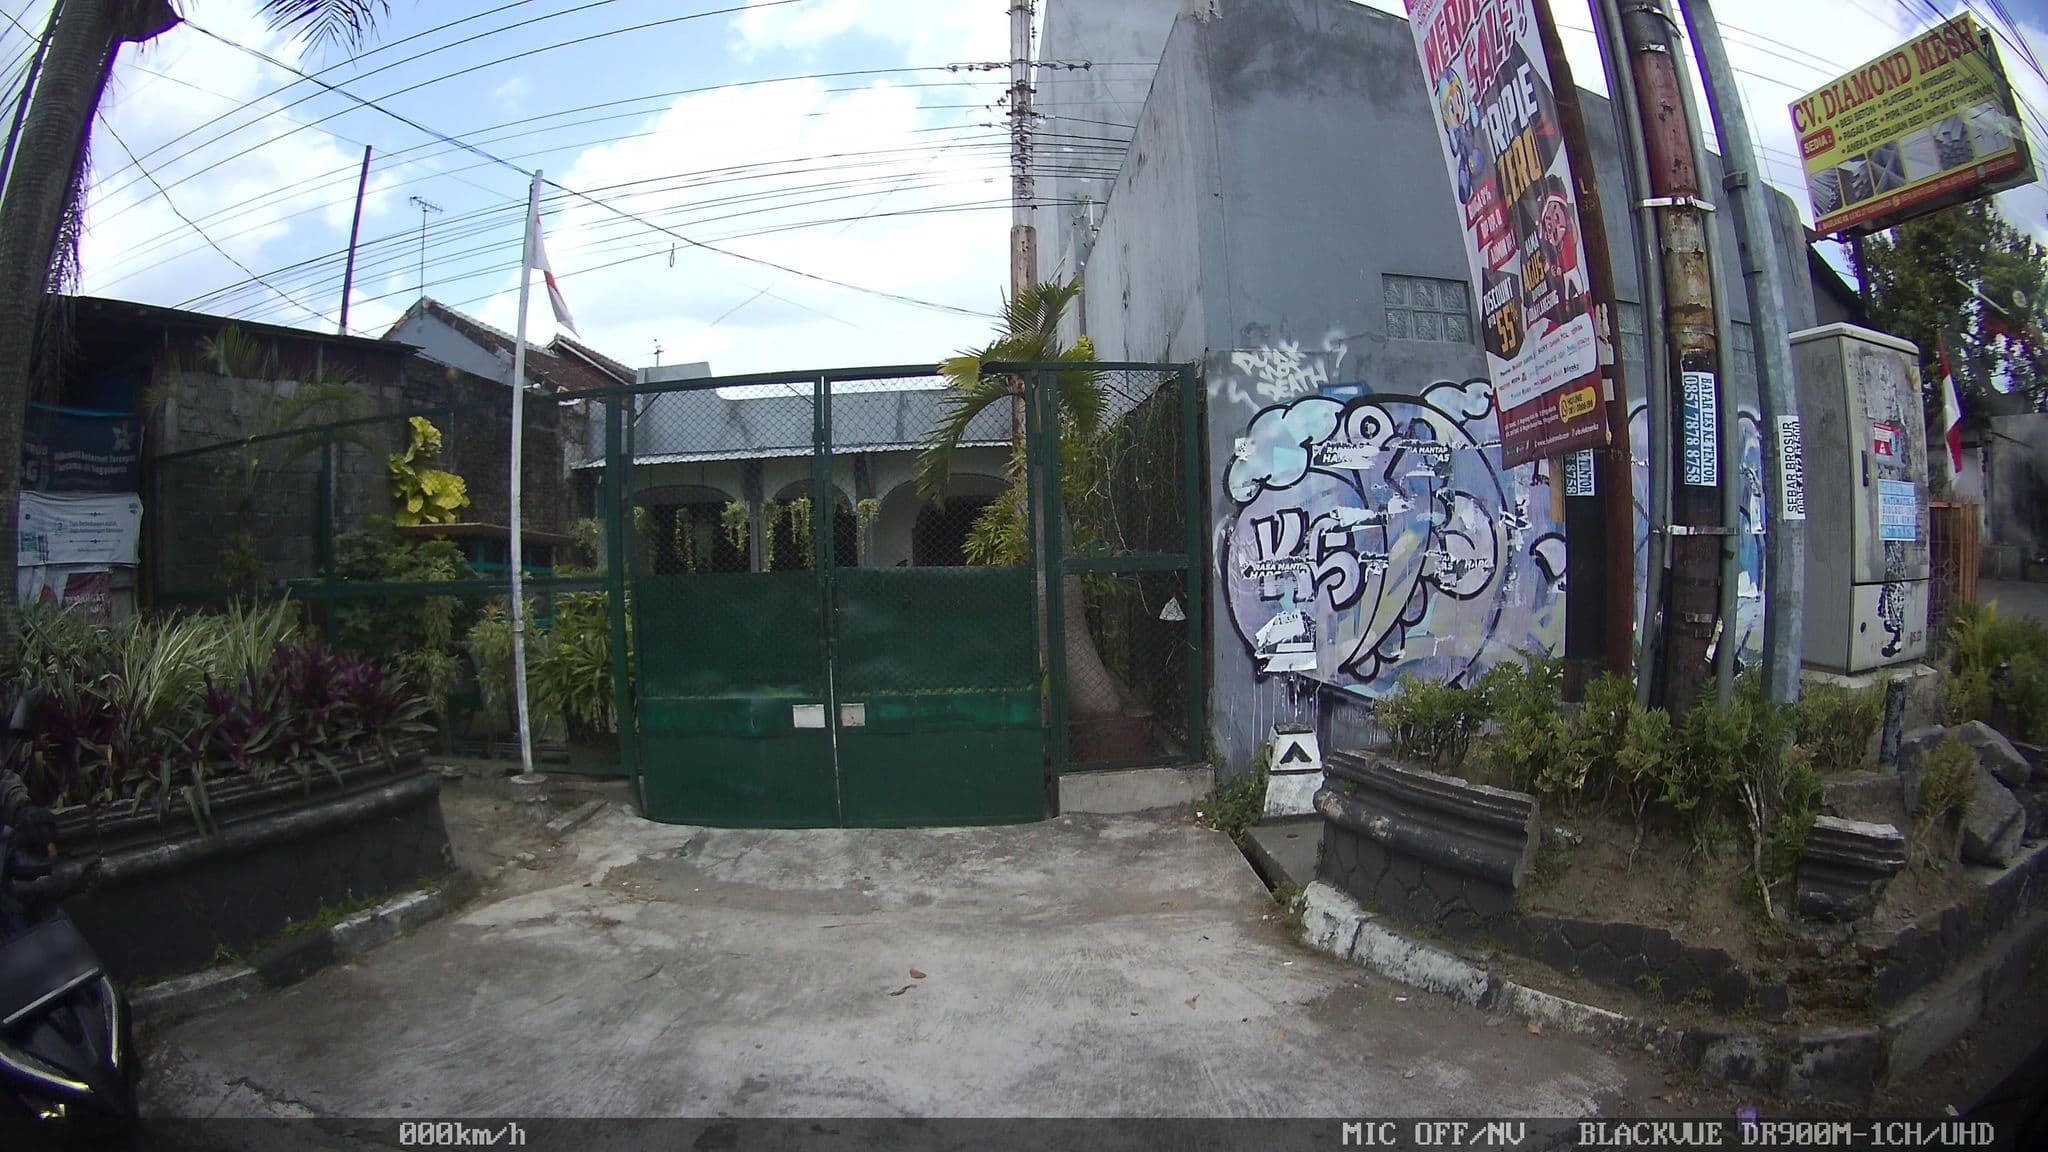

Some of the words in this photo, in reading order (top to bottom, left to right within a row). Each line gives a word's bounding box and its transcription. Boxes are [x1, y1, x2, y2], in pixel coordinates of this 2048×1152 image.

[1792, 97, 1822, 133] CV.
[1819, 52, 1912, 122] DIAMOND
[1911, 18, 1979, 76] MESH
[1481, 62, 1538, 164] TRIPLE
[1803, 136, 1828, 153] SEDIA
[1498, 126, 1543, 209] ZERO
[1483, 276, 1514, 316] DISCOUNT
[1684, 376, 1699, 409] 0857
[1701, 377, 1713, 409] BAYAR
[1685, 412, 1700, 446] 7878
[1702, 411, 1713, 429] LES
[1703, 430, 1714, 444] KE
[1783, 422, 1797, 470] BROSUR
[1566, 464, 1577, 494] 8758
[1686, 450, 1701, 483] 8758
[1703, 445, 1715, 483] TENTOR
[1787, 473, 1798, 513] SEBAR
